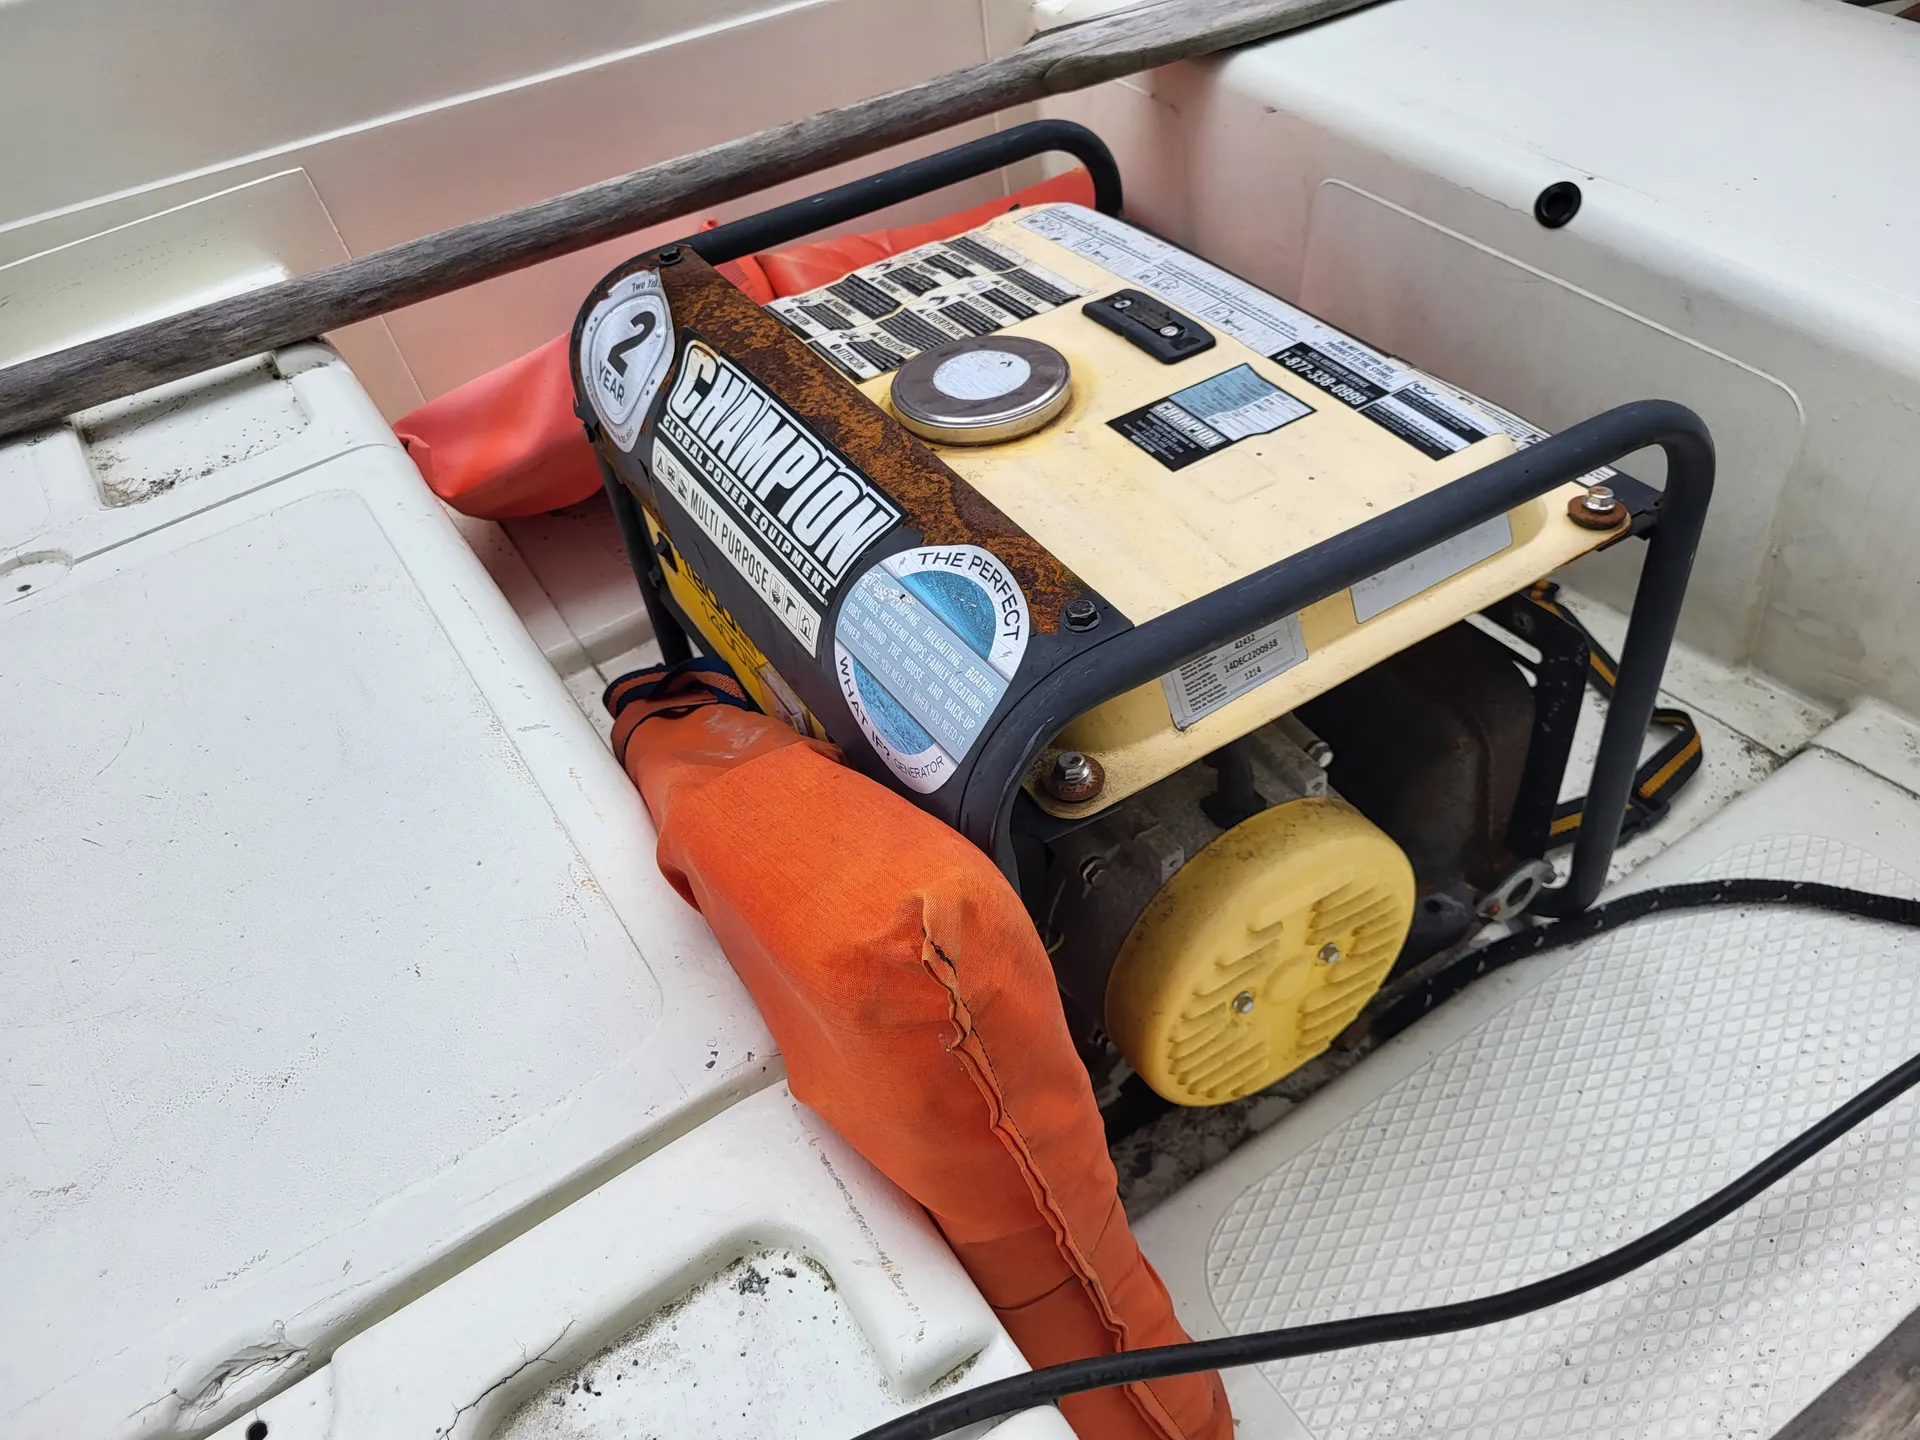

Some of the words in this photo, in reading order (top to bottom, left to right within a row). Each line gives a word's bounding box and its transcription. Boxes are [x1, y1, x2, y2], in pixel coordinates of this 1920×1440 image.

[632, 282, 645, 292] Two
[967, 295, 1008, 320] ADVERTENCIA
[1002, 280, 1042, 306] ADVERTENCIA
[608, 311, 656, 378] 2
[599, 360, 624, 407] YEAR
[1277, 352, 1368, 405] 1-877-338-0999
[1154, 401, 1222, 446] CHAMPION
[670, 342, 892, 576] CHAMPION
[663, 415, 704, 466] GLOBAL
[706, 457, 748, 510] POWER
[750, 513, 831, 596] EQUIPMENT
[690, 489, 719, 536] MULTI
[721, 523, 770, 592] PURPOSE
[918, 552, 967, 568] THE
[968, 555, 1020, 640] PERFECT
[846, 602, 860, 622] JOBS
[862, 617, 887, 646] AROUND
[890, 642, 902, 660] THE
[902, 656, 926, 685] HOUSE,
[928, 683, 944, 700] AND
[944, 698, 976, 730] BACK-UP
[854, 588, 880, 618] OUTINGS,
[880, 608, 911, 643] WEEKEND
[907, 635, 926, 661] TRIPS,
[924, 655, 949, 681] FAMILY
[947, 673, 986, 718] VACATIONS,
[890, 599, 920, 630] CAMPING,
[923, 626, 961, 669] TAILGATING,
[964, 665, 997, 702] BOATING,
[1224, 639, 1278, 674] 14DEC2200938
[1234, 634, 1256, 650] 42432
[1244, 666, 1262, 680] 1214
[839, 656, 868, 726] WHAT
[872, 730, 890, 760] IF?
[893, 755, 944, 778] GENERATOR
[880, 655, 892, 675] YOU
[891, 666, 906, 690] NEED
[914, 687, 930, 710] WHEN
[930, 704, 943, 724] YOU
[942, 716, 958, 742] NEED
